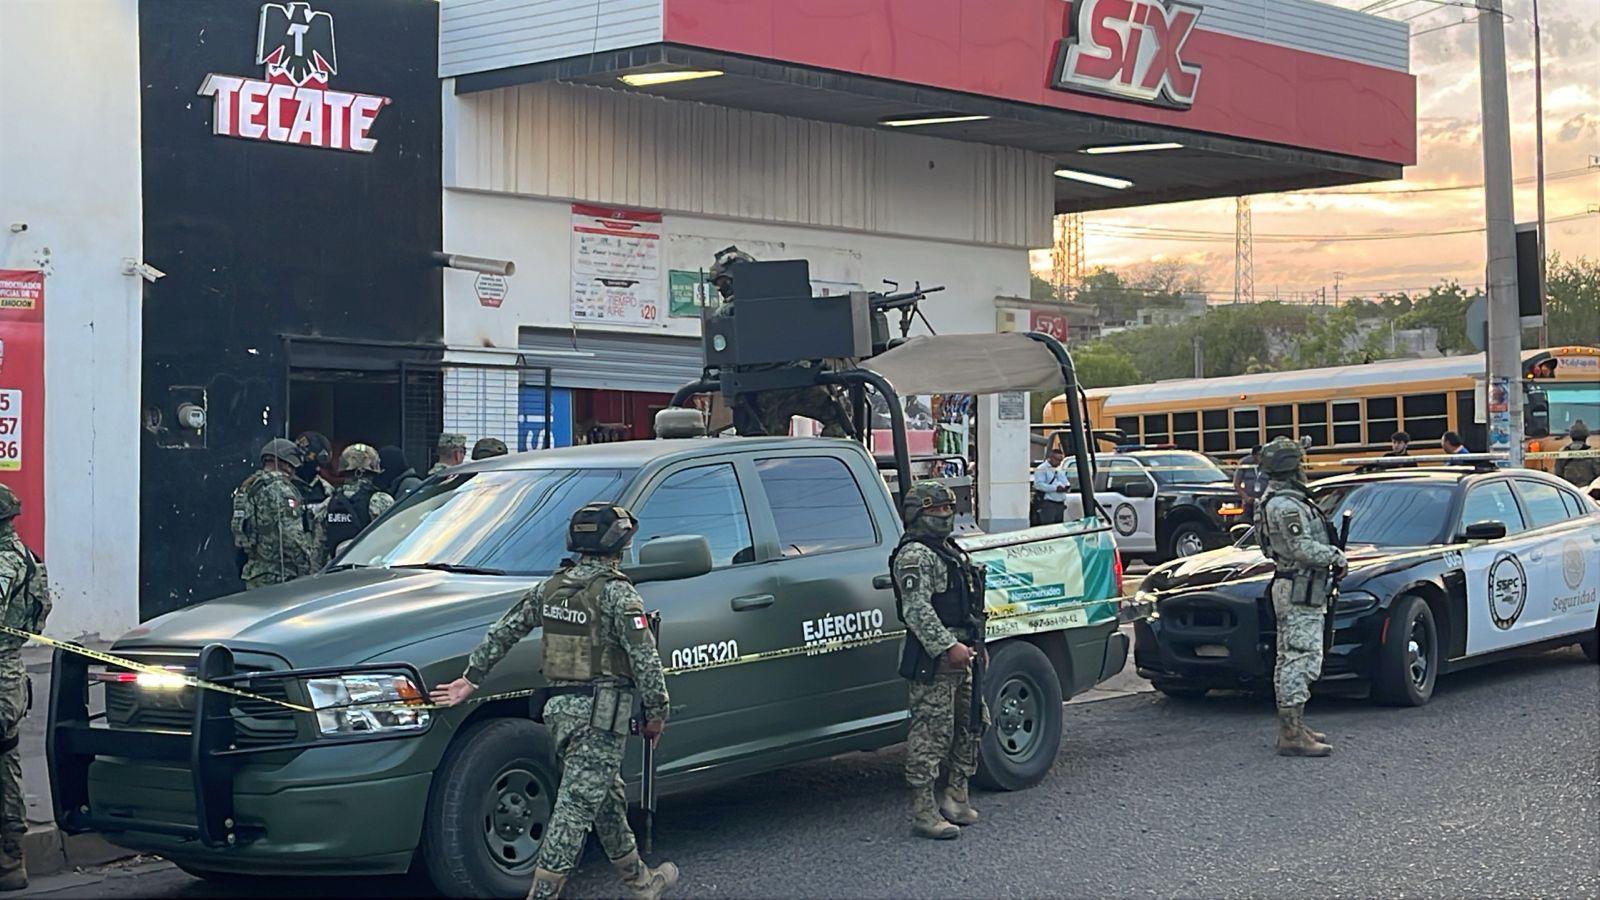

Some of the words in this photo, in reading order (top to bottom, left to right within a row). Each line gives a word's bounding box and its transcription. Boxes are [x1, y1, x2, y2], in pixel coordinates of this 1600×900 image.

[286, 23, 309, 56] T
[201, 75, 384, 151] TECATE
[1551, 588, 1597, 613] Seguridad
[802, 608, 884, 641] EJÉRCITO
[671, 639, 739, 672] 0915320
